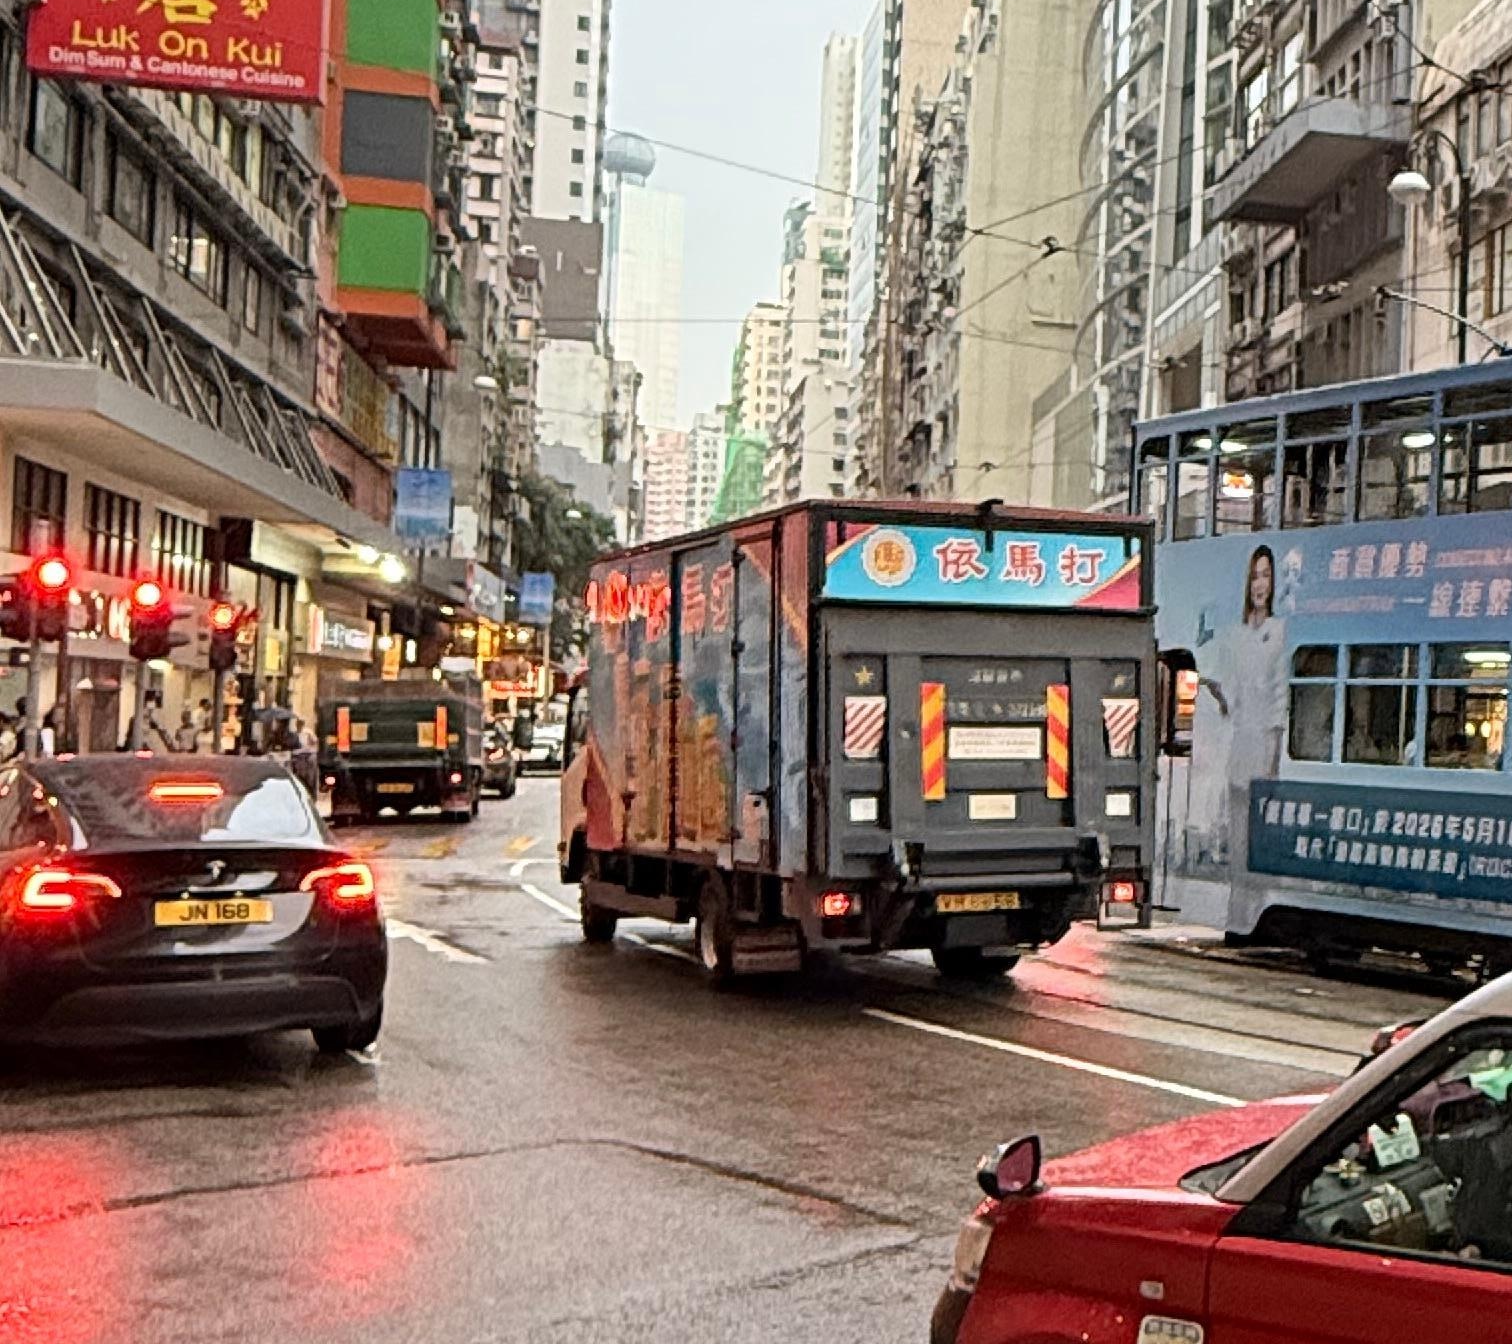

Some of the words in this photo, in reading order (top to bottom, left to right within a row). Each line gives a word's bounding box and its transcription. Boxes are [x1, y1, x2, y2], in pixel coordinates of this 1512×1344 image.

[71, 20, 140, 52] Luk
[159, 30, 209, 60] On
[227, 37, 283, 68] Kui
[49, 46, 85, 64] Dim
[87, 48, 126, 69] Sum
[130, 53, 143, 71] &
[147, 57, 238, 82] Cantonese
[240, 66, 306, 88] Cuisine
[935, 539, 1104, 586] 依馬打
[179, 904, 209, 922] JN
[216, 903, 250, 920] 168
